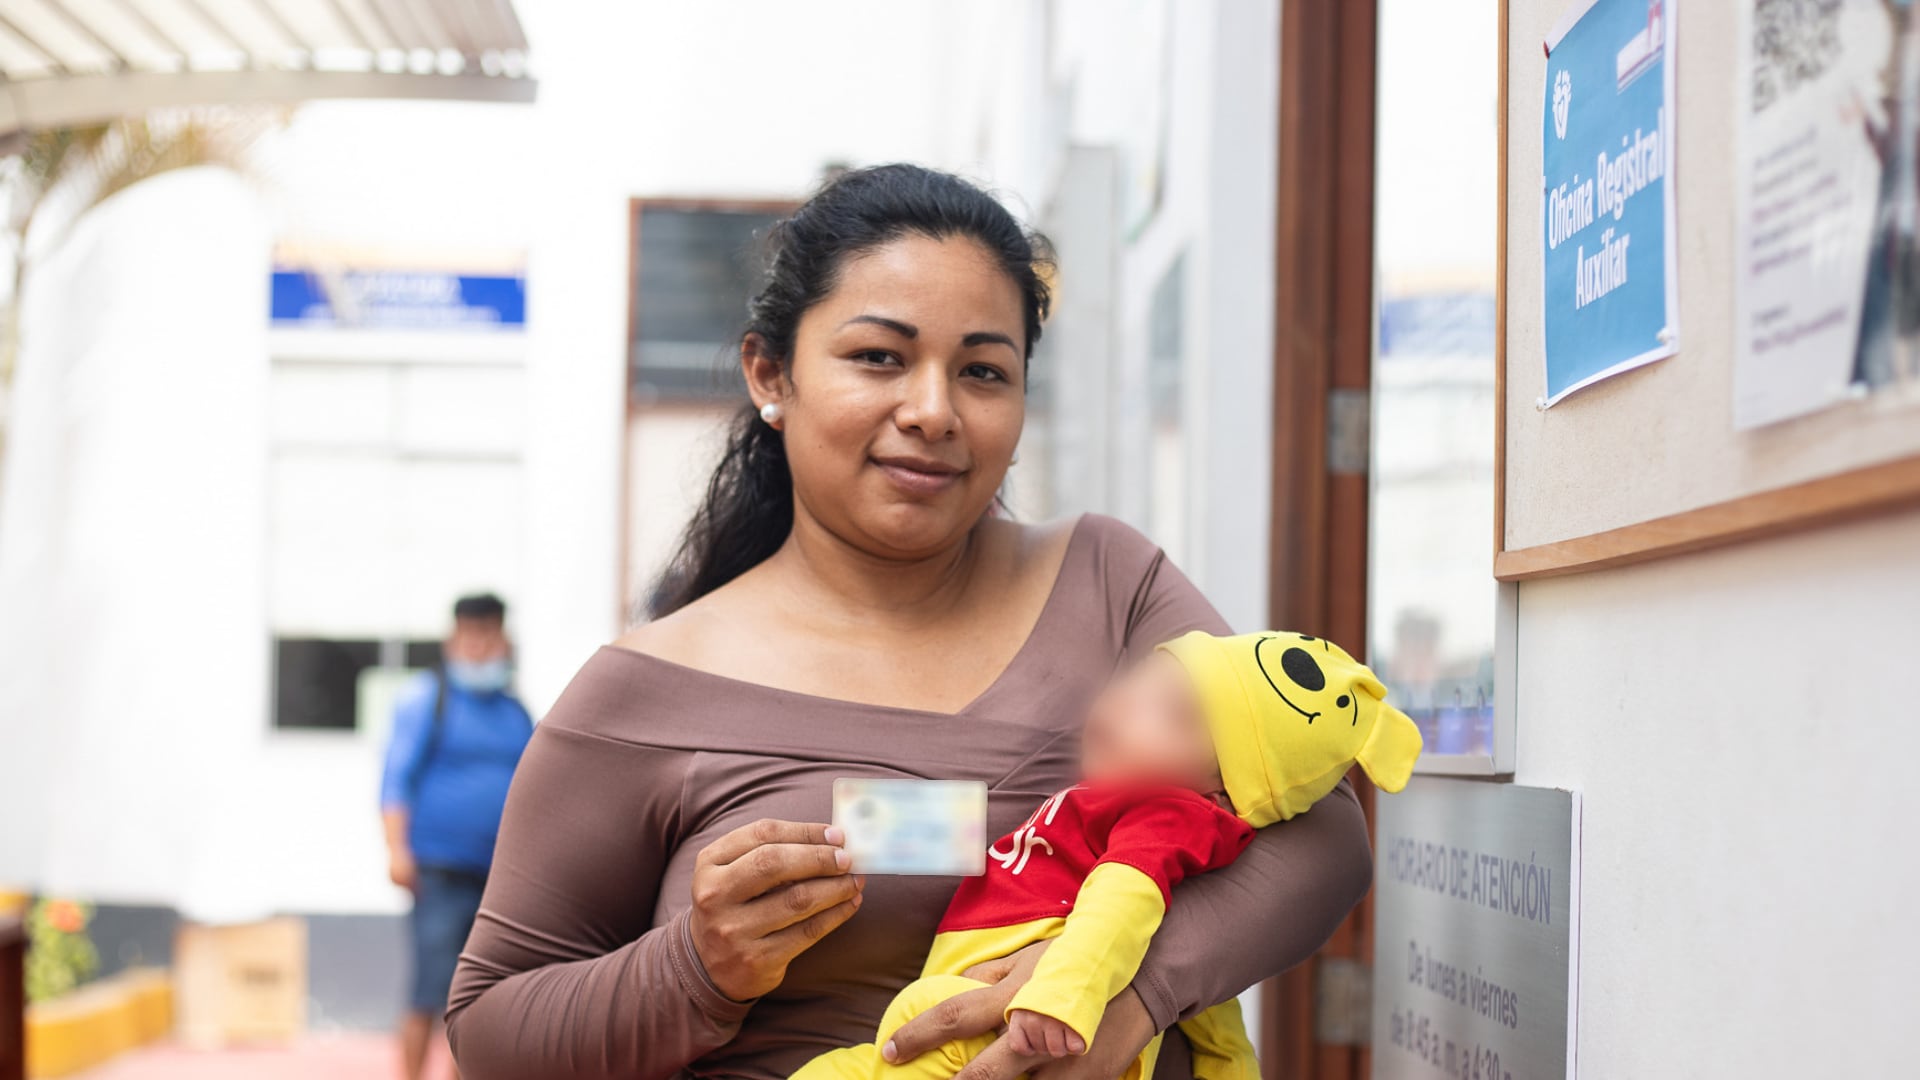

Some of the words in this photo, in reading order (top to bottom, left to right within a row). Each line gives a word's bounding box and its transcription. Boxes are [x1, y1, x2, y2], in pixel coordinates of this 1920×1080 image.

[1549, 174, 1594, 250] Oficina
[1597, 107, 1664, 221] Registral
[1576, 227, 1630, 311] Auxiliar
[1387, 837, 1446, 894] HORARIO
[1450, 848, 1469, 900] DE
[1471, 851, 1551, 925] ATENCIÓN
[1408, 940, 1423, 985] De
[1426, 946, 1457, 1000] lunes
[1459, 971, 1467, 1006] a
[1470, 965, 1518, 1030] viernes
[1462, 1049, 1470, 1080] a
